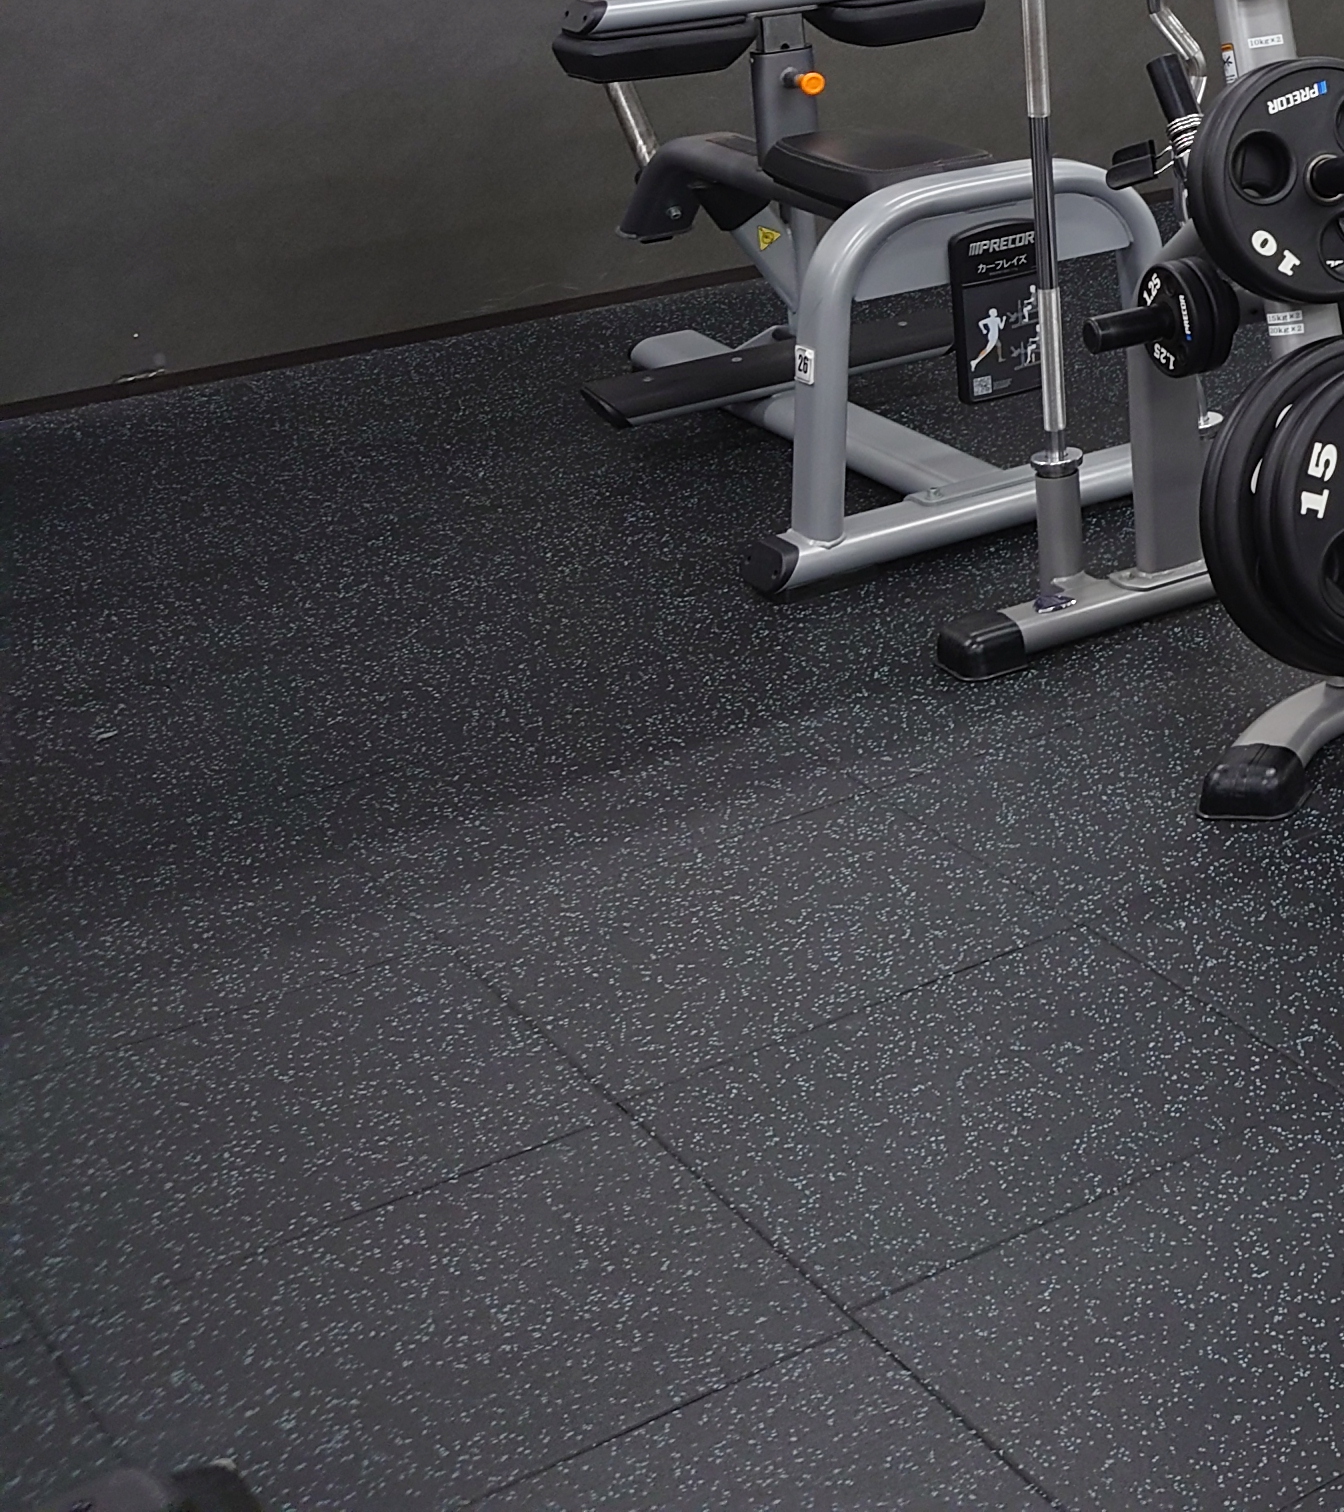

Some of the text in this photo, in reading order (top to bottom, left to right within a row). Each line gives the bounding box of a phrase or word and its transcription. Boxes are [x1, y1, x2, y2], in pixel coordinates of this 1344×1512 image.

[1266, 84, 1319, 114] PRECOR
[981, 232, 1036, 255] PRECOR
[1251, 229, 1301, 277] 10
[977, 254, 1028, 274] カーフレイズ
[1143, 272, 1162, 305] 1.25
[1178, 294, 1191, 336] PRECOR
[797, 353, 810, 374] 26
[1153, 344, 1176, 371] 1.25
[1300, 441, 1339, 519] 15
